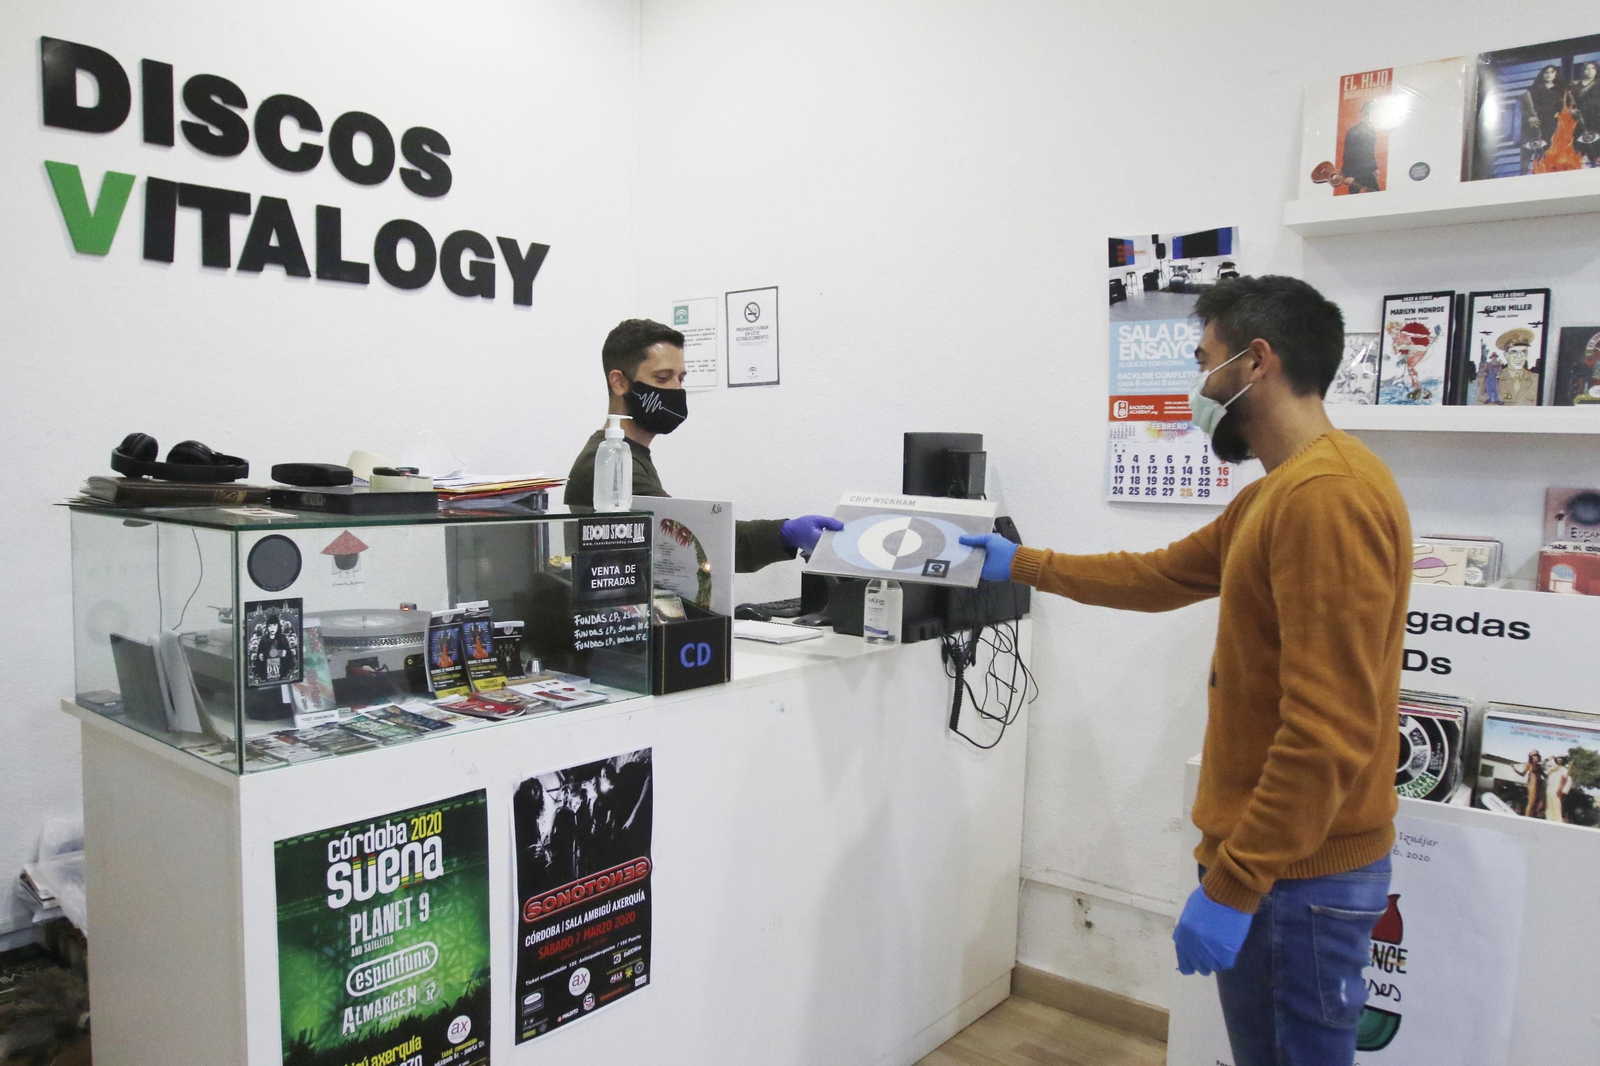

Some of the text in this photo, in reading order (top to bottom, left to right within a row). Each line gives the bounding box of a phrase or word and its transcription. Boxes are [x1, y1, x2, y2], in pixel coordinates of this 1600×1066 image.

[1344, 76, 1357, 92] EL
[1361, 70, 1389, 89] HIJO
[40, 36, 452, 198] DISCOS
[44, 159, 550, 306] VITALOGY
[1390, 305, 1444, 316] MARILYN MONROE
[1508, 303, 1533, 311] MILLER
[1119, 322, 1201, 343] SALA DE
[1119, 340, 1198, 361] ENSAYO
[1117, 371, 1198, 380] BACKLINE COMPLETO
[1152, 422, 1188, 430] FEBRERO
[1203, 444, 1209, 453] 1
[1116, 455, 1209, 464] 3 4 5 6 7 8
[1114, 465, 1229, 475] 10 11 12 13 14 15 16
[1114, 476, 1228, 487] 17 18 19 20 21 22 23
[850, 495, 917, 507] CHIP WICKHAM
[1112, 486, 1210, 497] 24 25 26 27 28 29
[583, 522, 645, 541] RECORD STORE DAY
[591, 564, 636, 576] VENTA DE
[591, 576, 636, 589] ENTRADAS
[574, 613, 607, 627] FUNDAS
[1405, 611, 1531, 640] gadas
[574, 628, 604, 639] FUNDAS
[574, 640, 605, 651] FUNDAS
[679, 642, 712, 668] CD
[1402, 648, 1452, 675] Ds
[1407, 771, 1430, 791] CHICOS
[327, 811, 442, 863] córdoba 2020
[1406, 851, 1431, 862] 2020
[350, 892, 430, 946] PLANET 9
[525, 888, 646, 947] CÓRDOBA SALA AMBIGÚ AXERQUÍA
[538, 935, 574, 960] SÁBADO
[576, 931, 581, 945] 7
[583, 920, 613, 941] MARZO
[614, 911, 637, 929] 2020
[351, 934, 394, 958] AND SATELLITES
[1371, 943, 1409, 974] NCE
[354, 946, 431, 991] espidifunk
[571, 972, 588, 987] ax
[342, 984, 417, 1037] ALMARGEN
[451, 1020, 468, 1035] ax
[371, 1034, 422, 1066] axerquía
